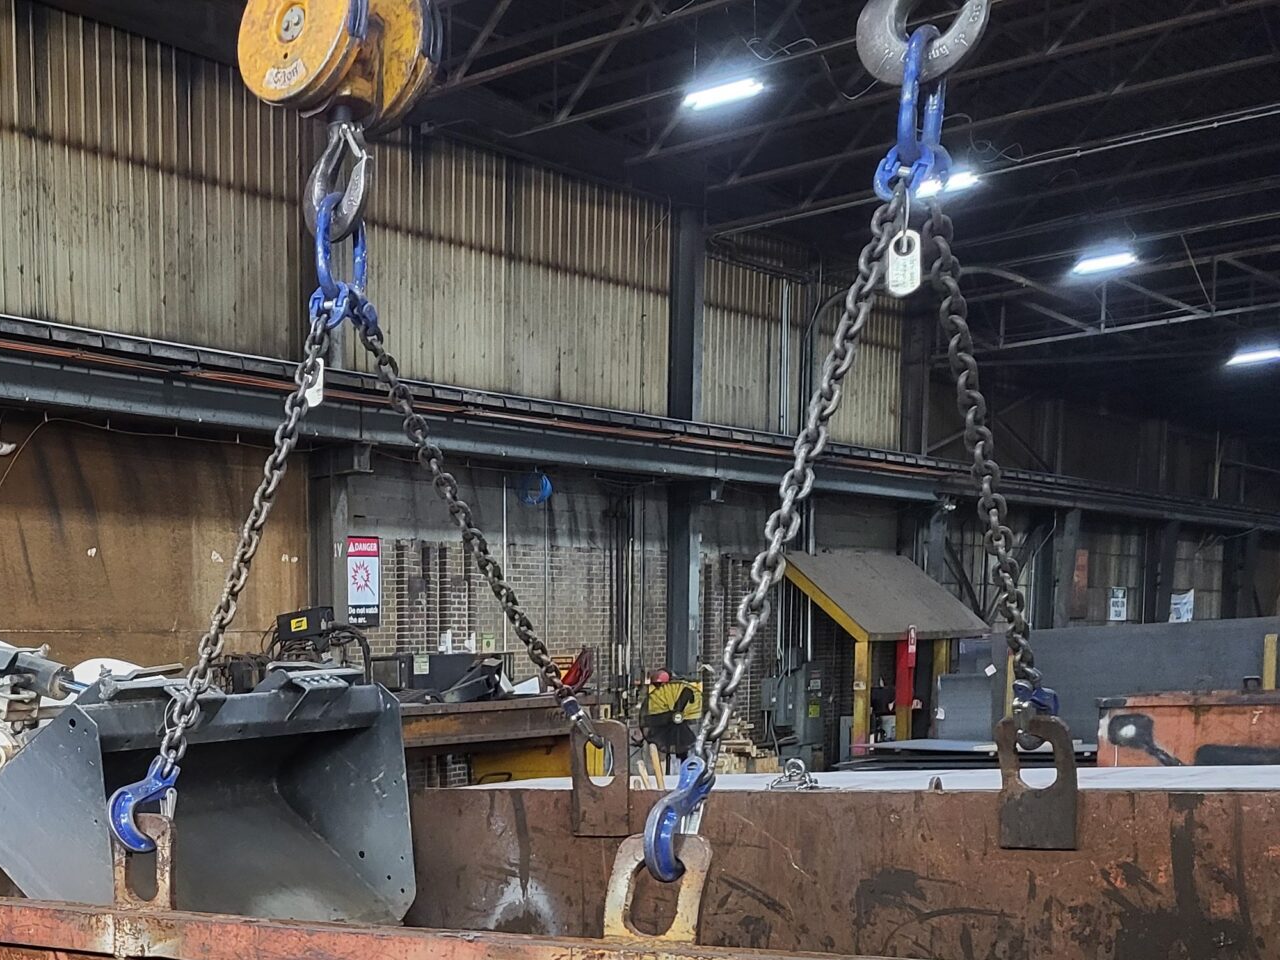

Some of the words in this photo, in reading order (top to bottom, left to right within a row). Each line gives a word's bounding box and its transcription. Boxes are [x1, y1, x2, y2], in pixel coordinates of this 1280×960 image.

[354, 542, 378, 552] DANGER
[348, 606, 356, 614] Do
[356, 606, 366, 614] not
[366, 605, 378, 614] watch
[348, 615, 357, 624] the
